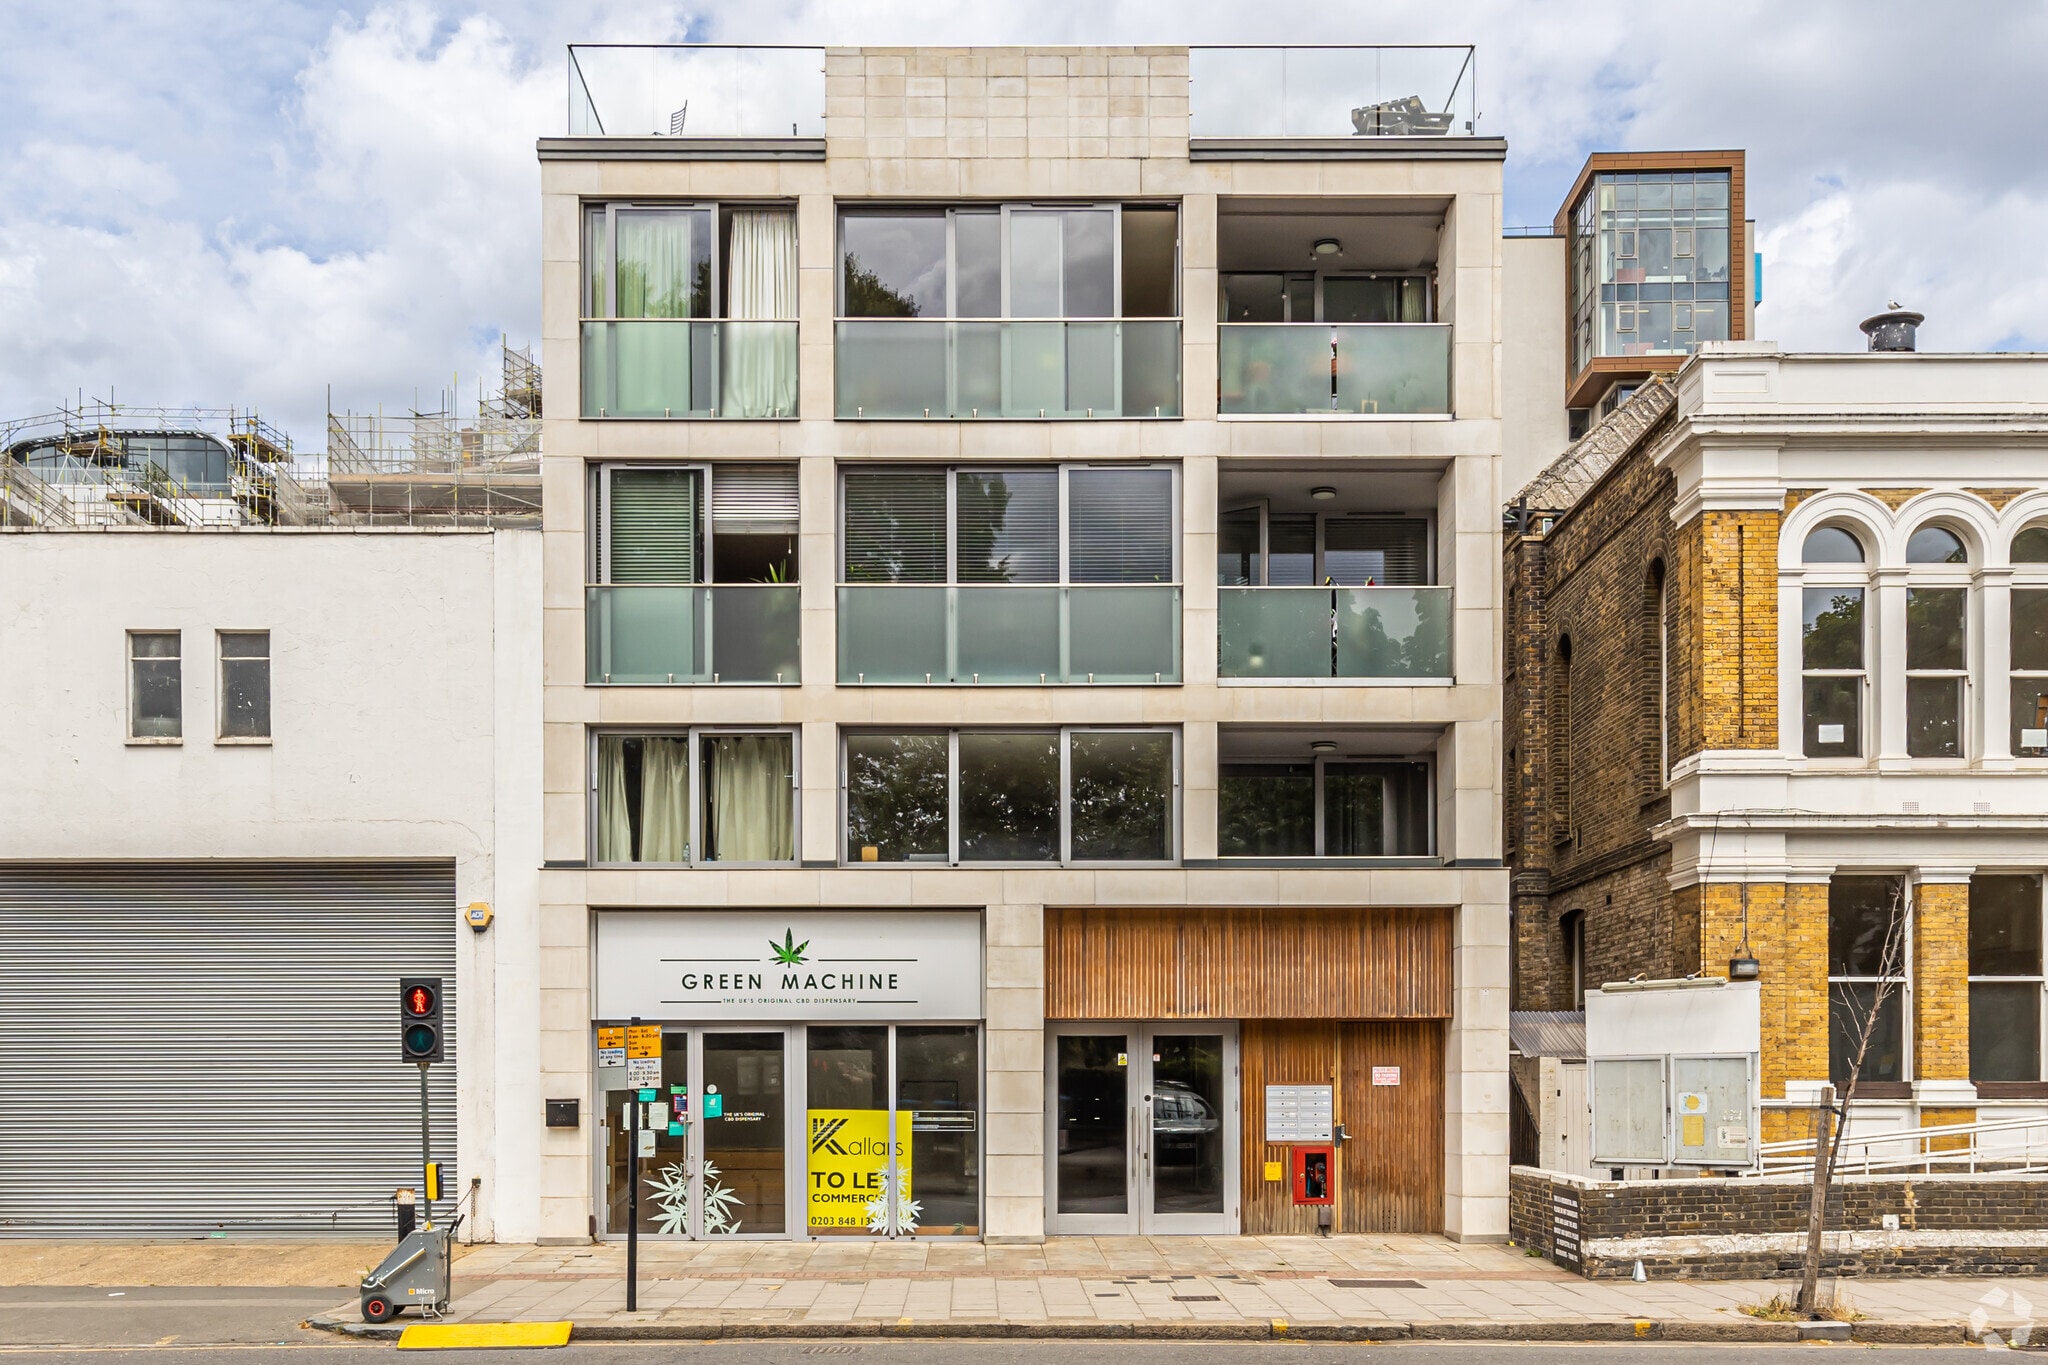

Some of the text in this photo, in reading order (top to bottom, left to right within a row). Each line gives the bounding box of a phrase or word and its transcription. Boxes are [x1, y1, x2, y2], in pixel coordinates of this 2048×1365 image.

[681, 973, 898, 990] GREEN MACHINE
[811, 1171, 889, 1189] TO LE
[812, 1193, 886, 1203] COMMERC
[811, 1216, 835, 1226] 0203
[838, 1216, 856, 1226] 848
